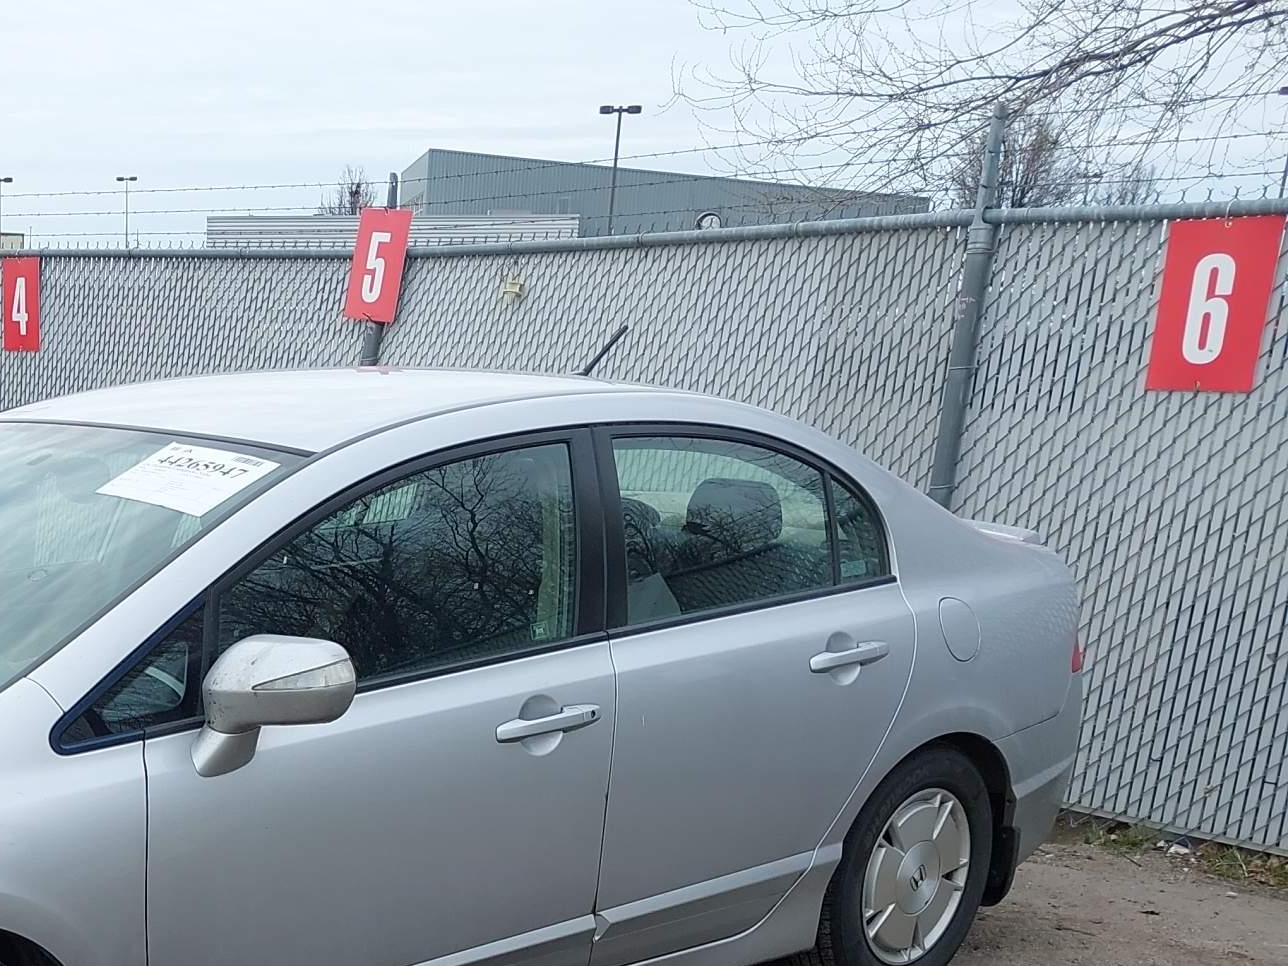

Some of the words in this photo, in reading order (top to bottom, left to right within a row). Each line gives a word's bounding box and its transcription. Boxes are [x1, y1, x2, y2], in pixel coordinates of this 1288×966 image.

[361, 231, 392, 304] 5
[12, 276, 29, 336] 4
[1182, 252, 1236, 365] 6
[157, 455, 249, 479] 44265947
